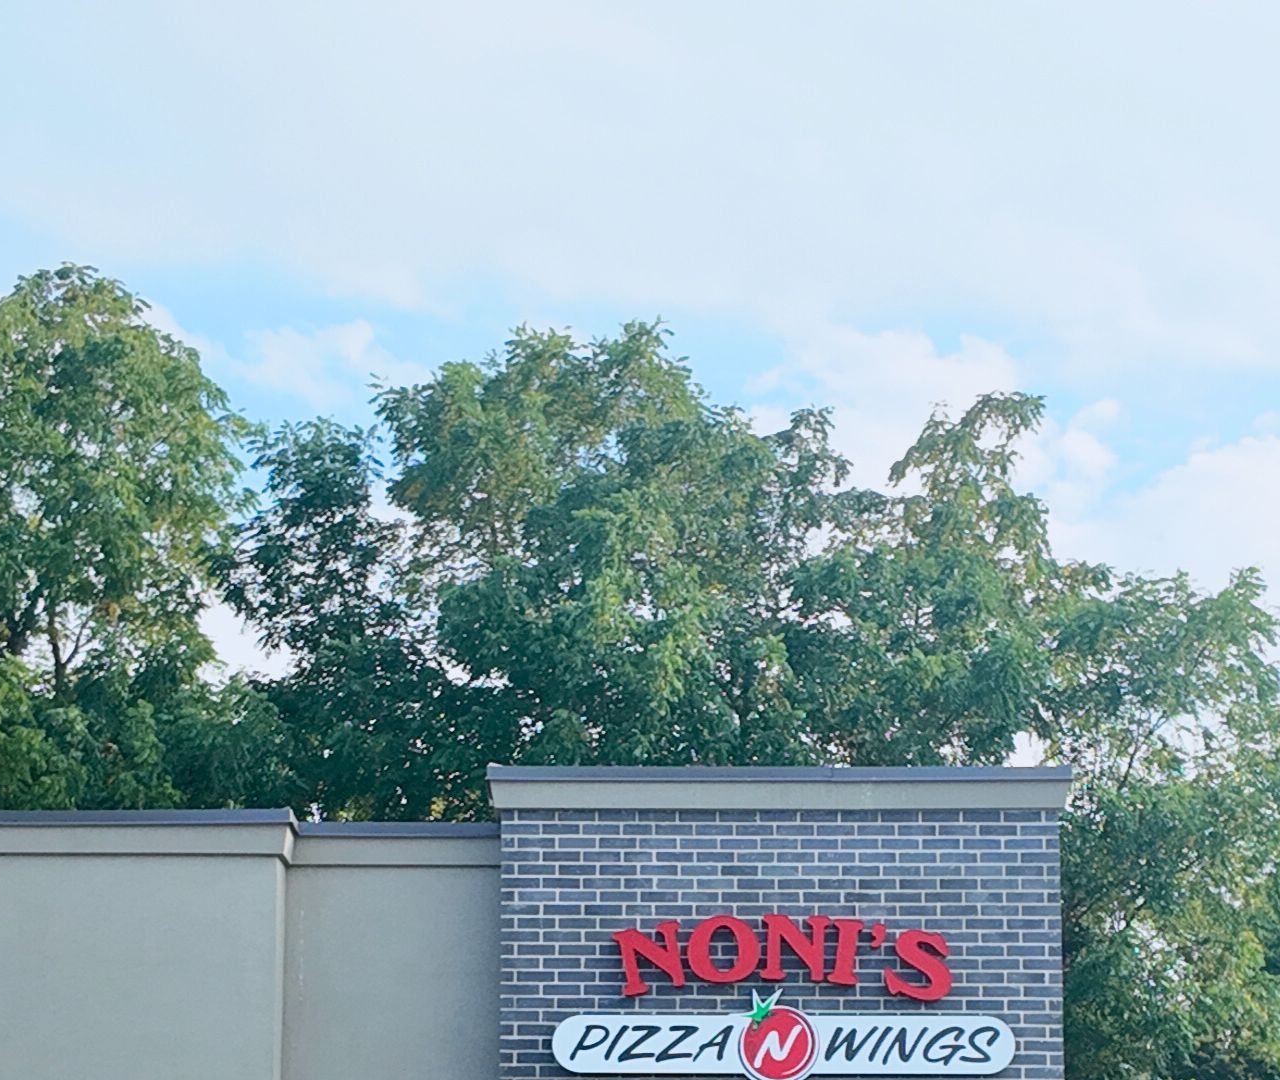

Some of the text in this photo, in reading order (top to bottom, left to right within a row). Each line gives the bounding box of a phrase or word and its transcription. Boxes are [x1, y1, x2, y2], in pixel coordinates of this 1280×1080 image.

[613, 913, 952, 1002] NONI'S
[569, 1024, 1001, 1068] PIZZA N WINGS
